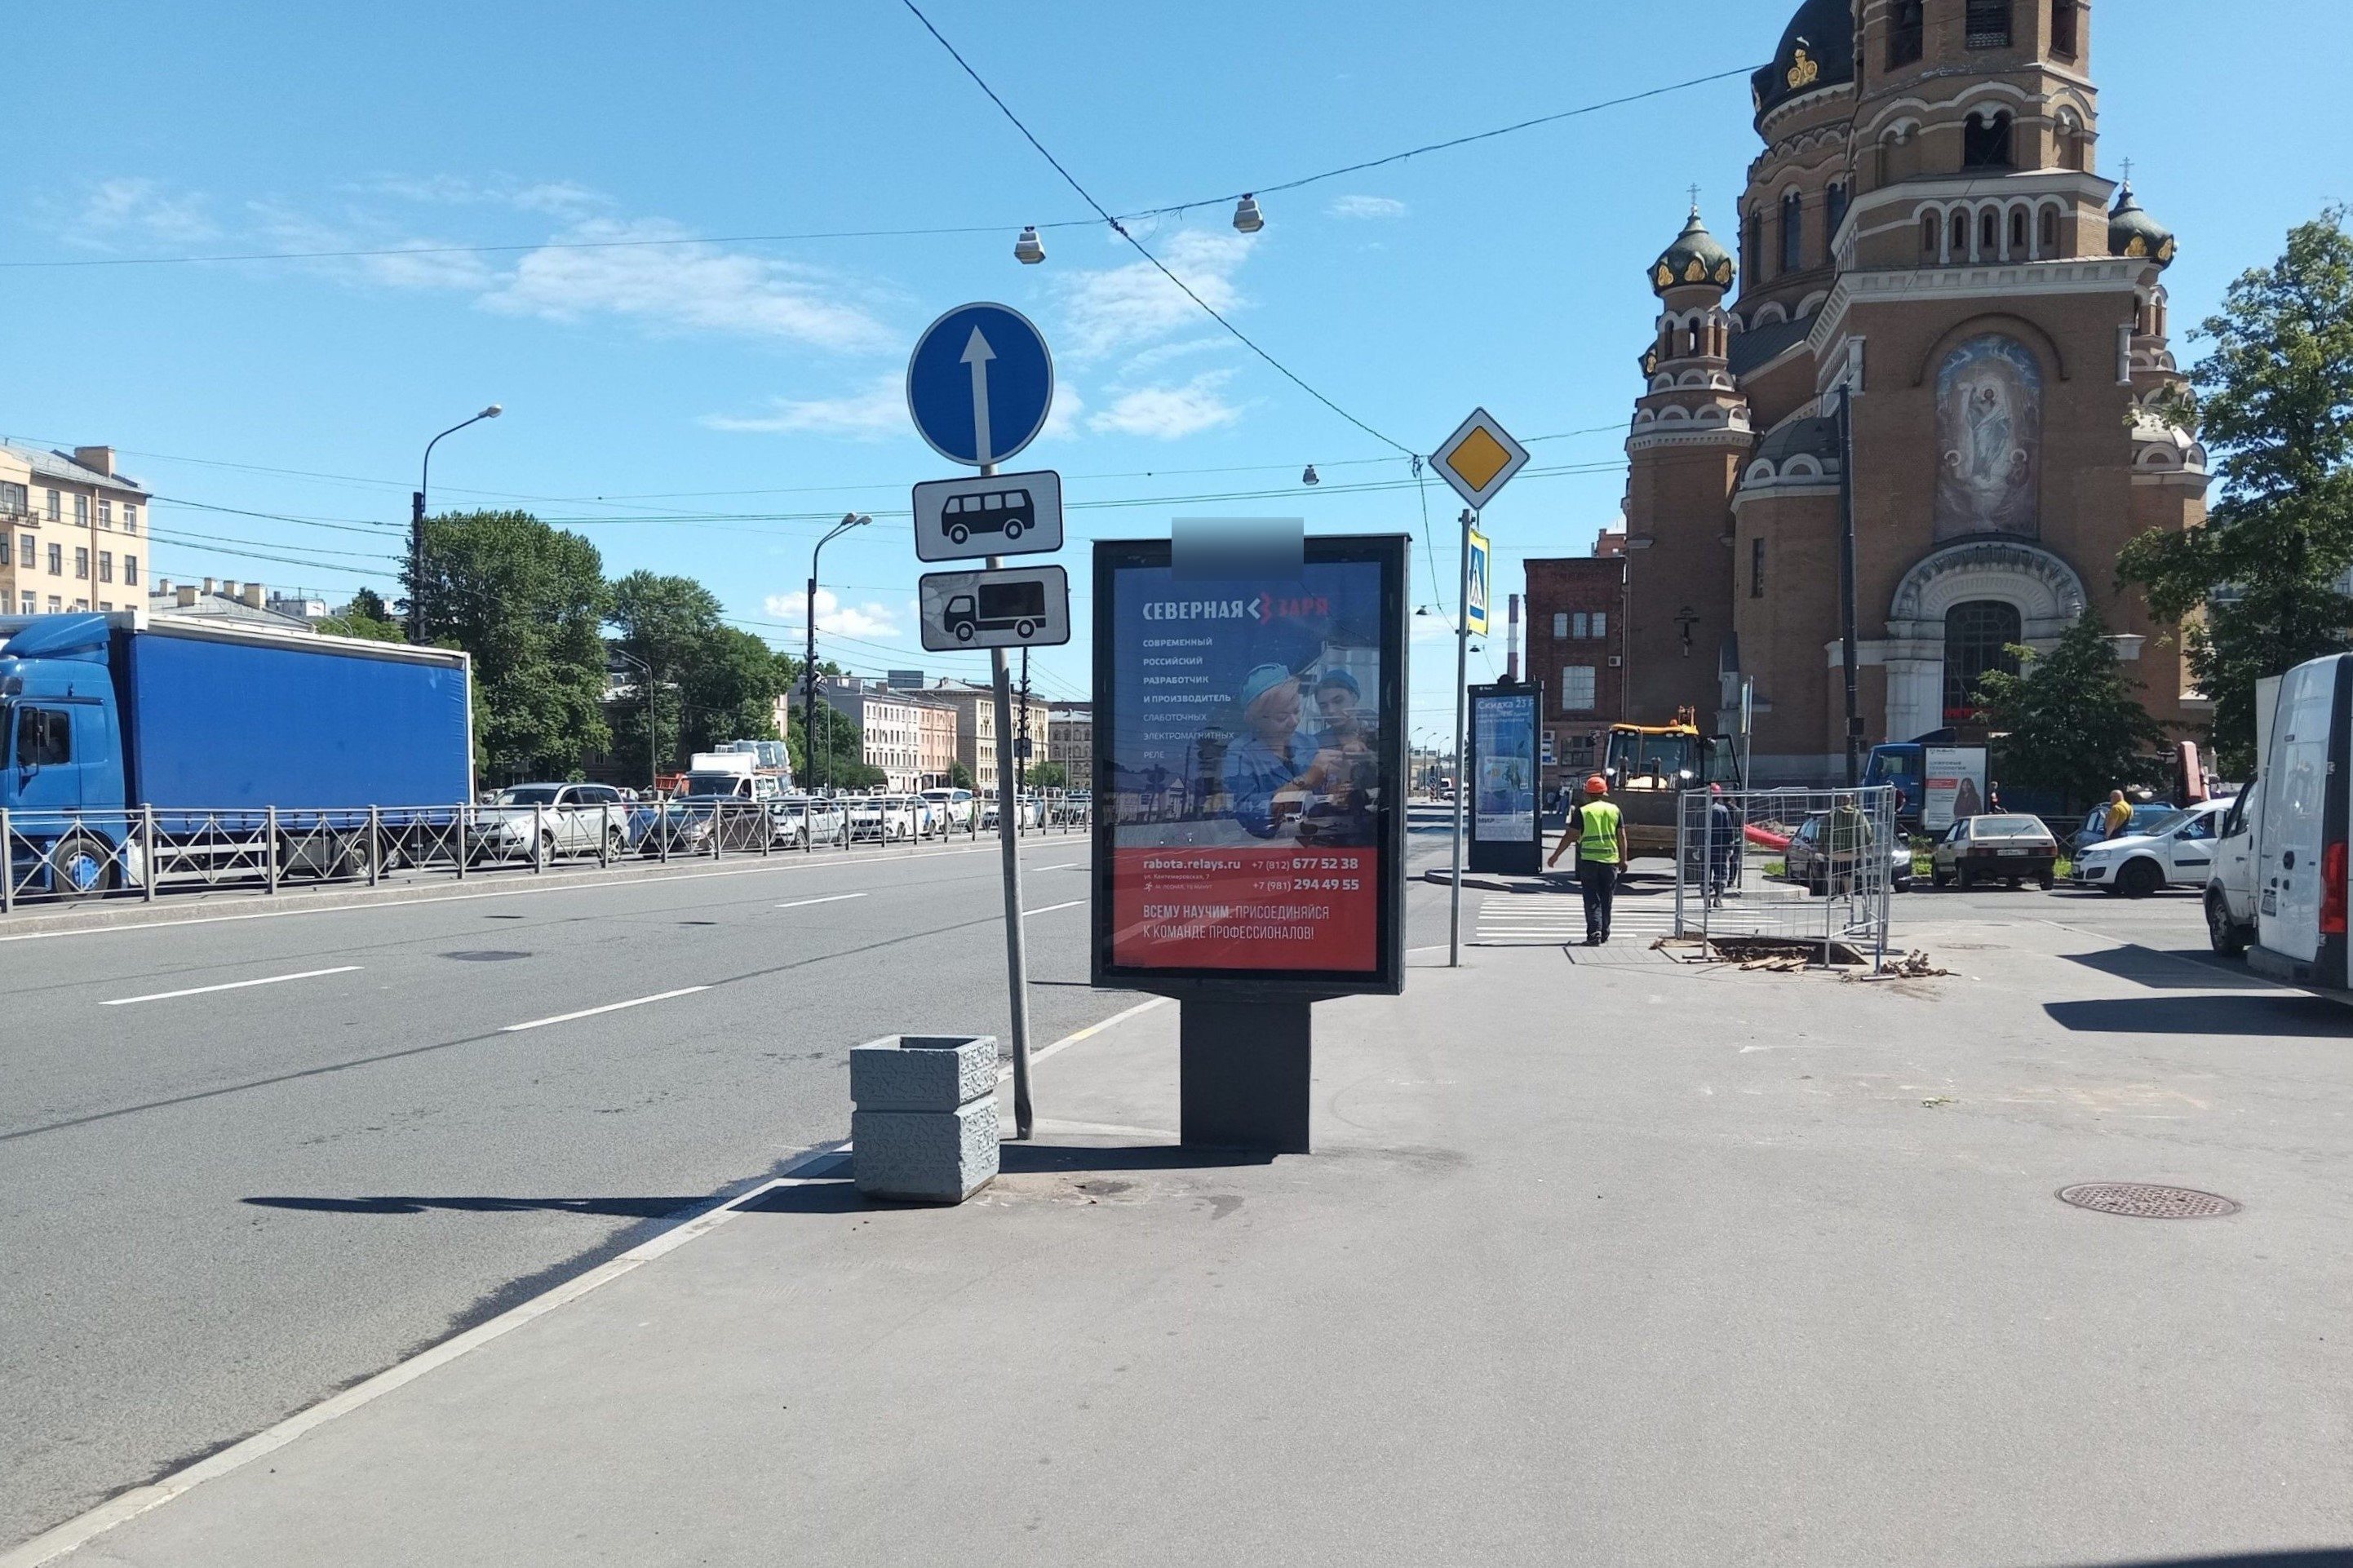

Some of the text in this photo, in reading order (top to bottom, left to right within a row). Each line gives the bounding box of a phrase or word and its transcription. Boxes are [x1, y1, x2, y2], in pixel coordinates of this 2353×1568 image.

[1143, 597, 1328, 620] СЕВЕРНАЯ ЗАРЯ
[1143, 637, 1212, 647] СОВРЕМЕННЫЙ
[1144, 656, 1203, 666] РОССИЙСКИЙ
[1144, 675, 1209, 684] РАЗРАБОТЧИК
[1144, 693, 1231, 703] И ПРОИЗВОДИТЕЛЬ
[1478, 701, 1513, 711] Скидка
[1143, 713, 1208, 722] СЛАБОТОЧНЫХ
[1143, 732, 1234, 741] ЭЛЕКТРОМАГНИТНЫХ
[1144, 751, 1165, 759] РЕЛЕ
[1143, 858, 1241, 871] rabota.relays.ru
[1252, 857, 1358, 871] +7 (812) 677 52 38
[1253, 879, 1359, 892] +7 (981) 294 49 55
[1143, 904, 1330, 920] ВСЕМУ НАУЧИМ. ПРИСОЕДИНЯЙСЯ
[1143, 924, 1314, 940] К КОМАНДЕ ПРОФЕССИОНАЛОВ!
